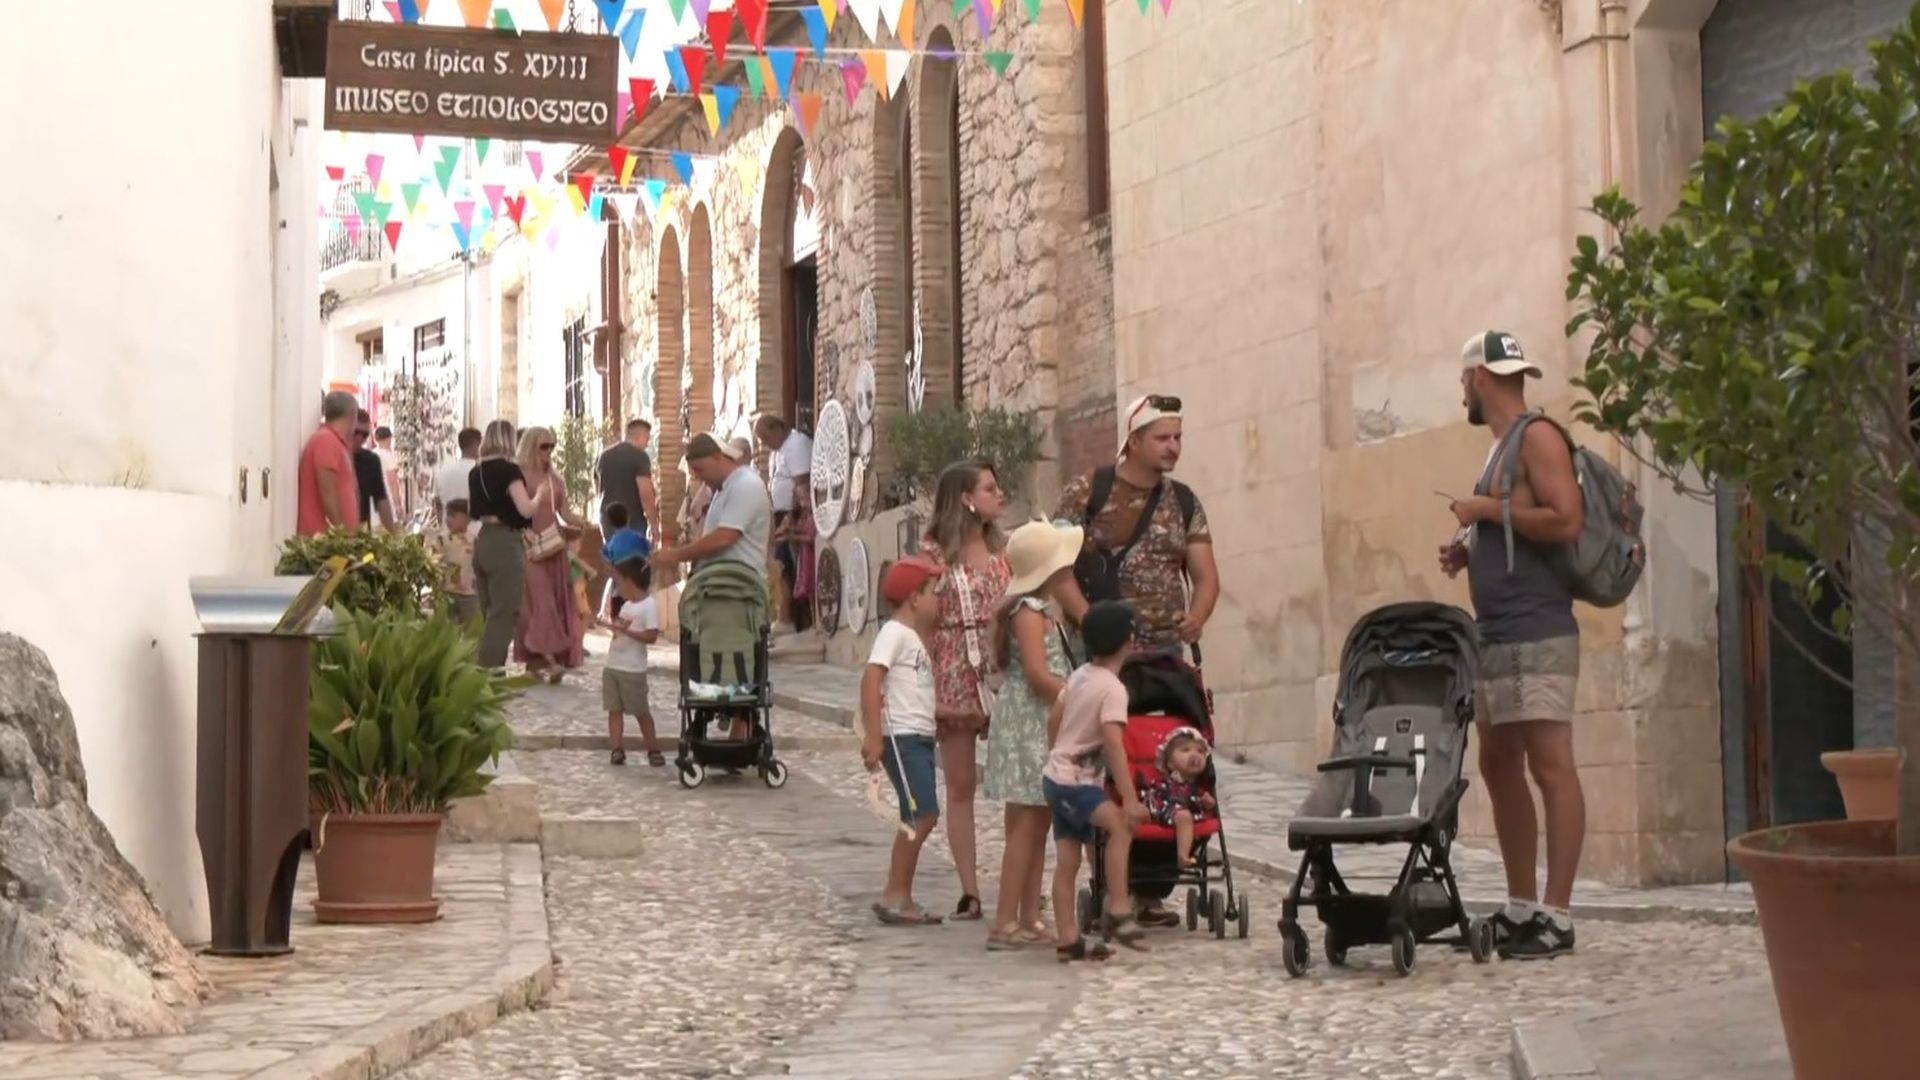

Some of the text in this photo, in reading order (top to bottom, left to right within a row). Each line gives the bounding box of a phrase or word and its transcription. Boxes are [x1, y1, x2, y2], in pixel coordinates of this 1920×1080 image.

[361, 44, 416, 71] Casa
[494, 51, 514, 75] S.
[523, 53, 588, 80] XVIII
[335, 86, 608, 125] MUSEO ETNOLOGICO
